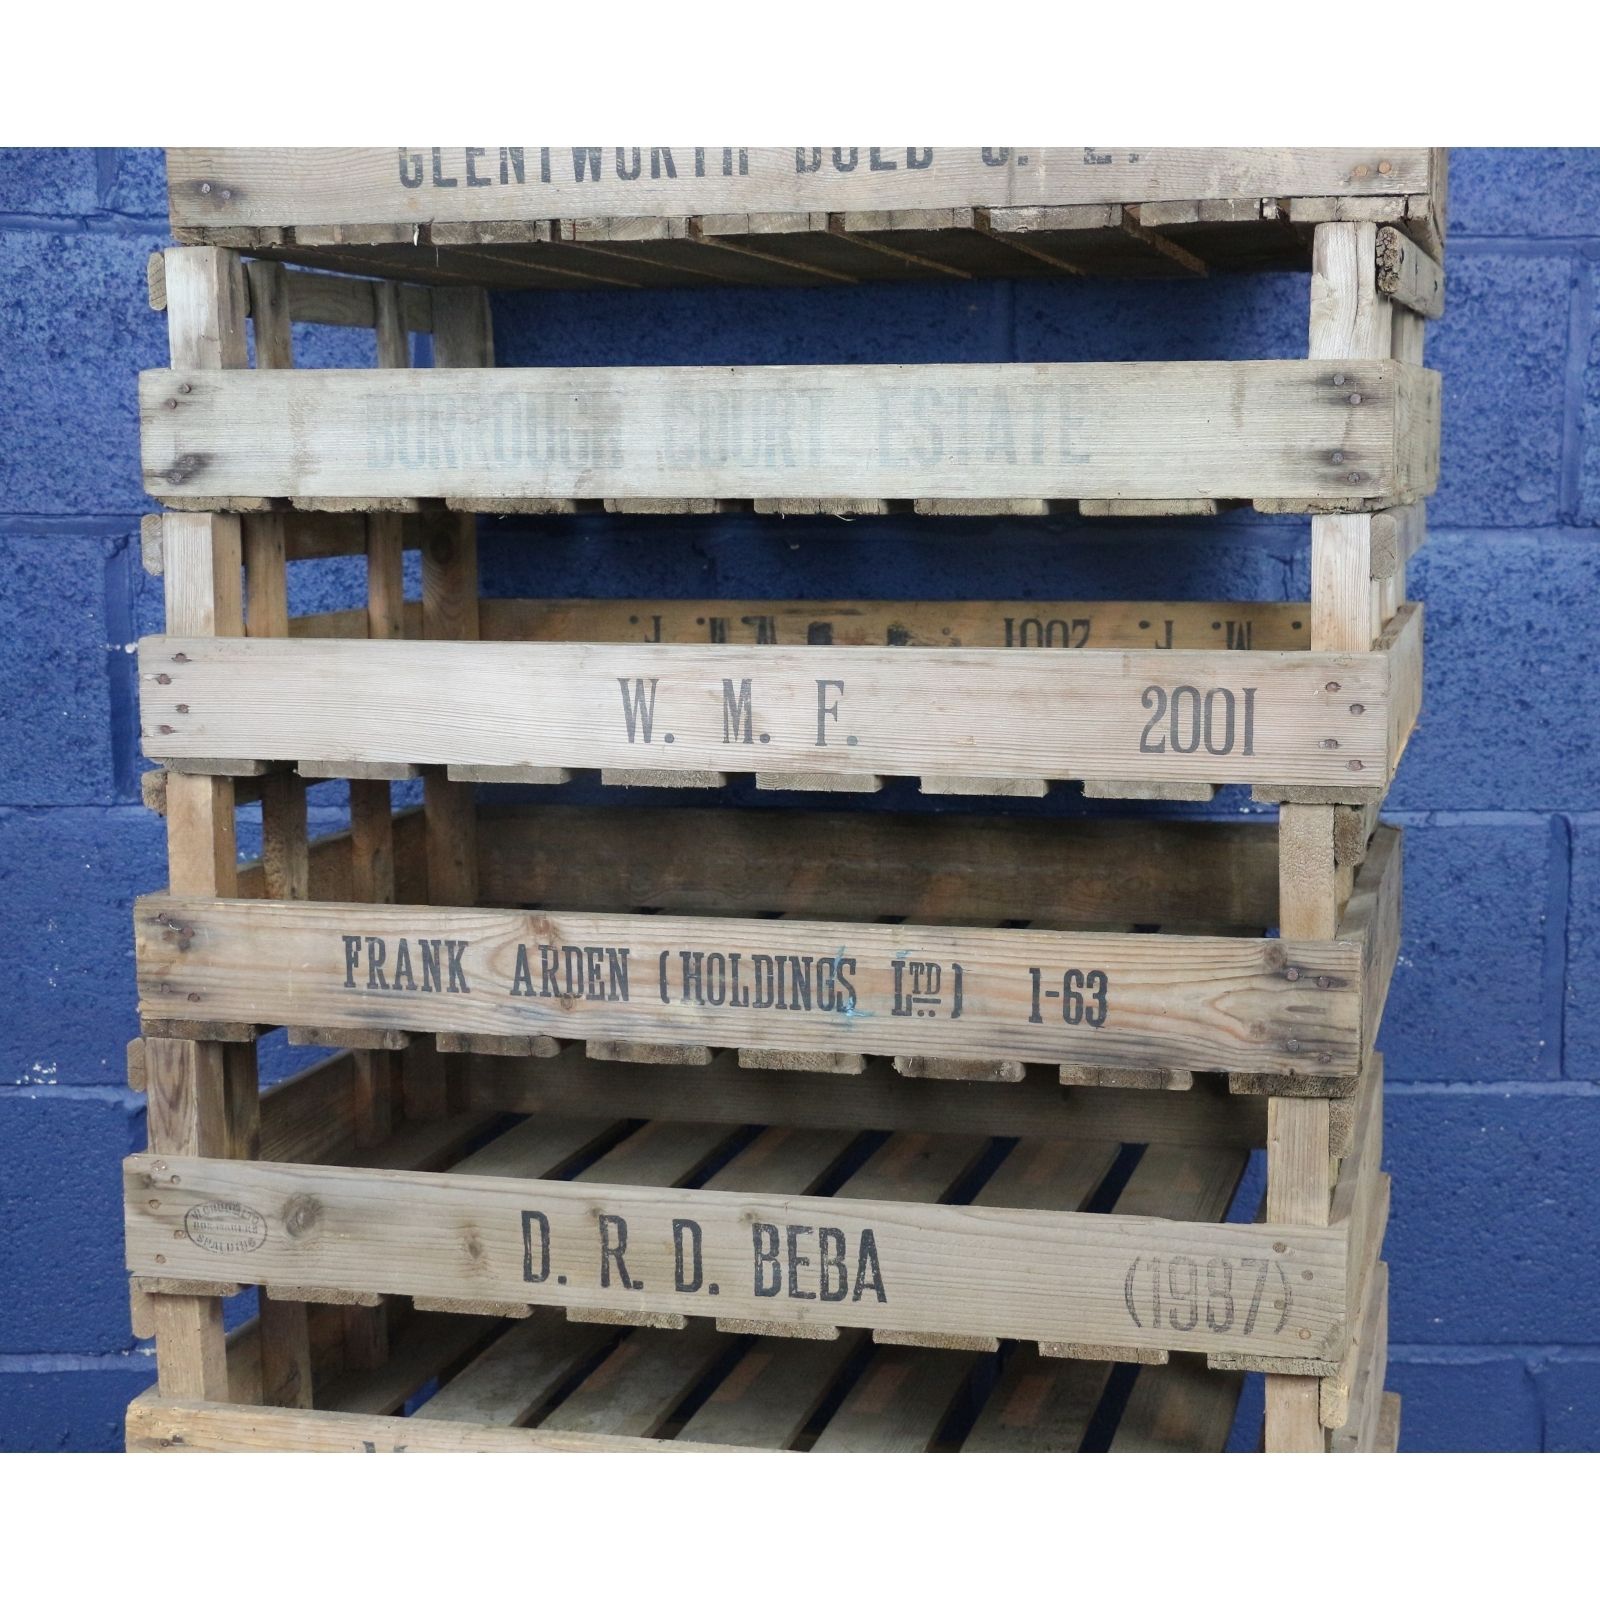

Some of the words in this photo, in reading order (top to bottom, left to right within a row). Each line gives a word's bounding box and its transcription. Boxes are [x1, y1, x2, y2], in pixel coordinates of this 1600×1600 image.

[616, 678, 675, 744] W.
[722, 678, 771, 745] M.
[815, 679, 859, 747] F.
[341, 935, 472, 994] FRANK
[510, 943, 631, 1002] ARDEN
[659, 949, 857, 1014] (HOLDINGS
[1027, 967, 1109, 1030] 1-63
[521, 1209, 567, 1286] D.
[599, 1214, 644, 1290] R.
[673, 1218, 721, 1296] D.
[752, 1222, 888, 1305] BEBA
